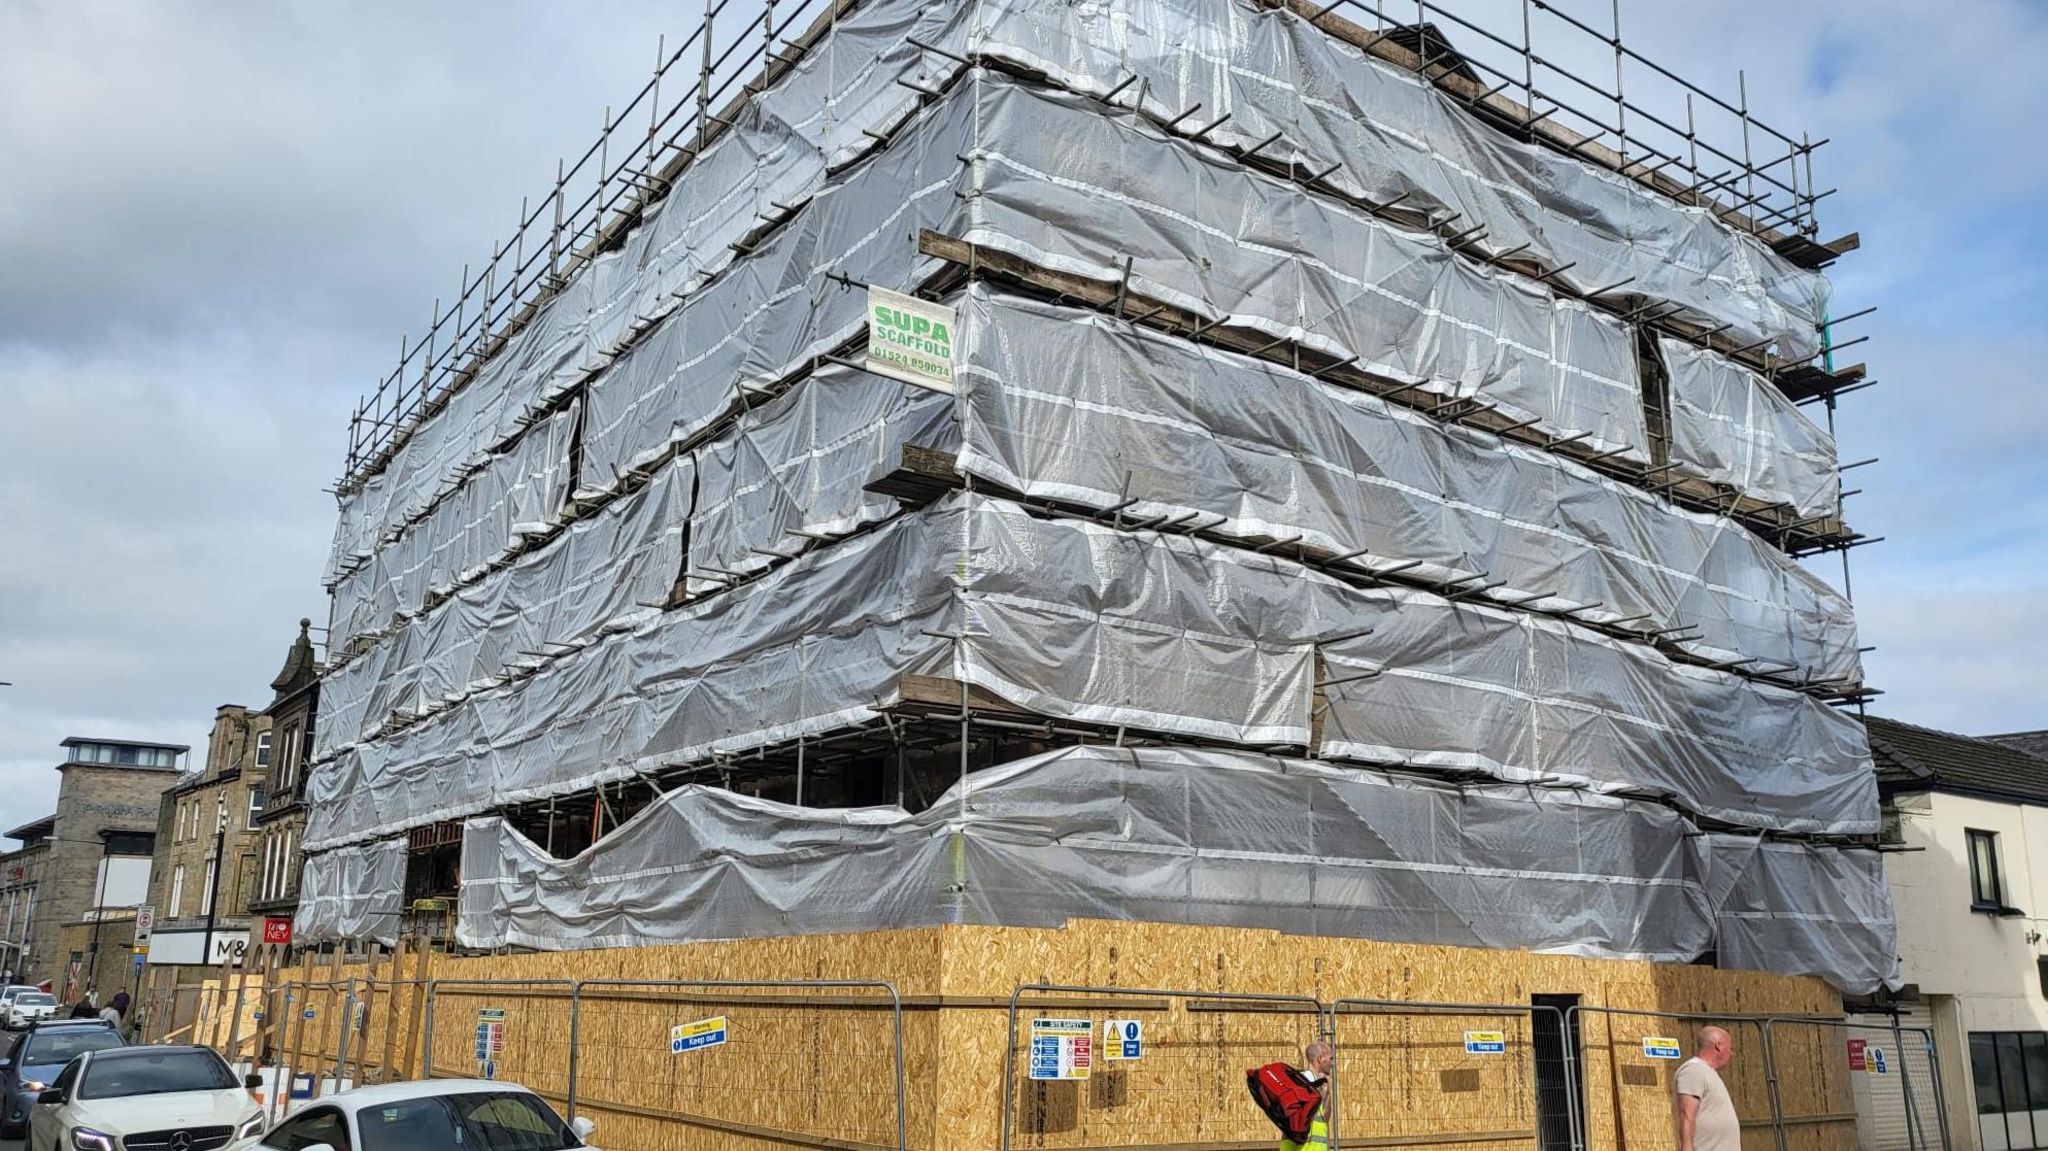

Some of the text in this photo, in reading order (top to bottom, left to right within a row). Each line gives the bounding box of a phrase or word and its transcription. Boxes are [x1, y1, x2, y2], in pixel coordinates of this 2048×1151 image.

[875, 306, 950, 344] SUPA
[877, 326, 950, 358] SCAFFOLD
[874, 347, 908, 367] 01524
[688, 1033, 717, 1046] Keep out
